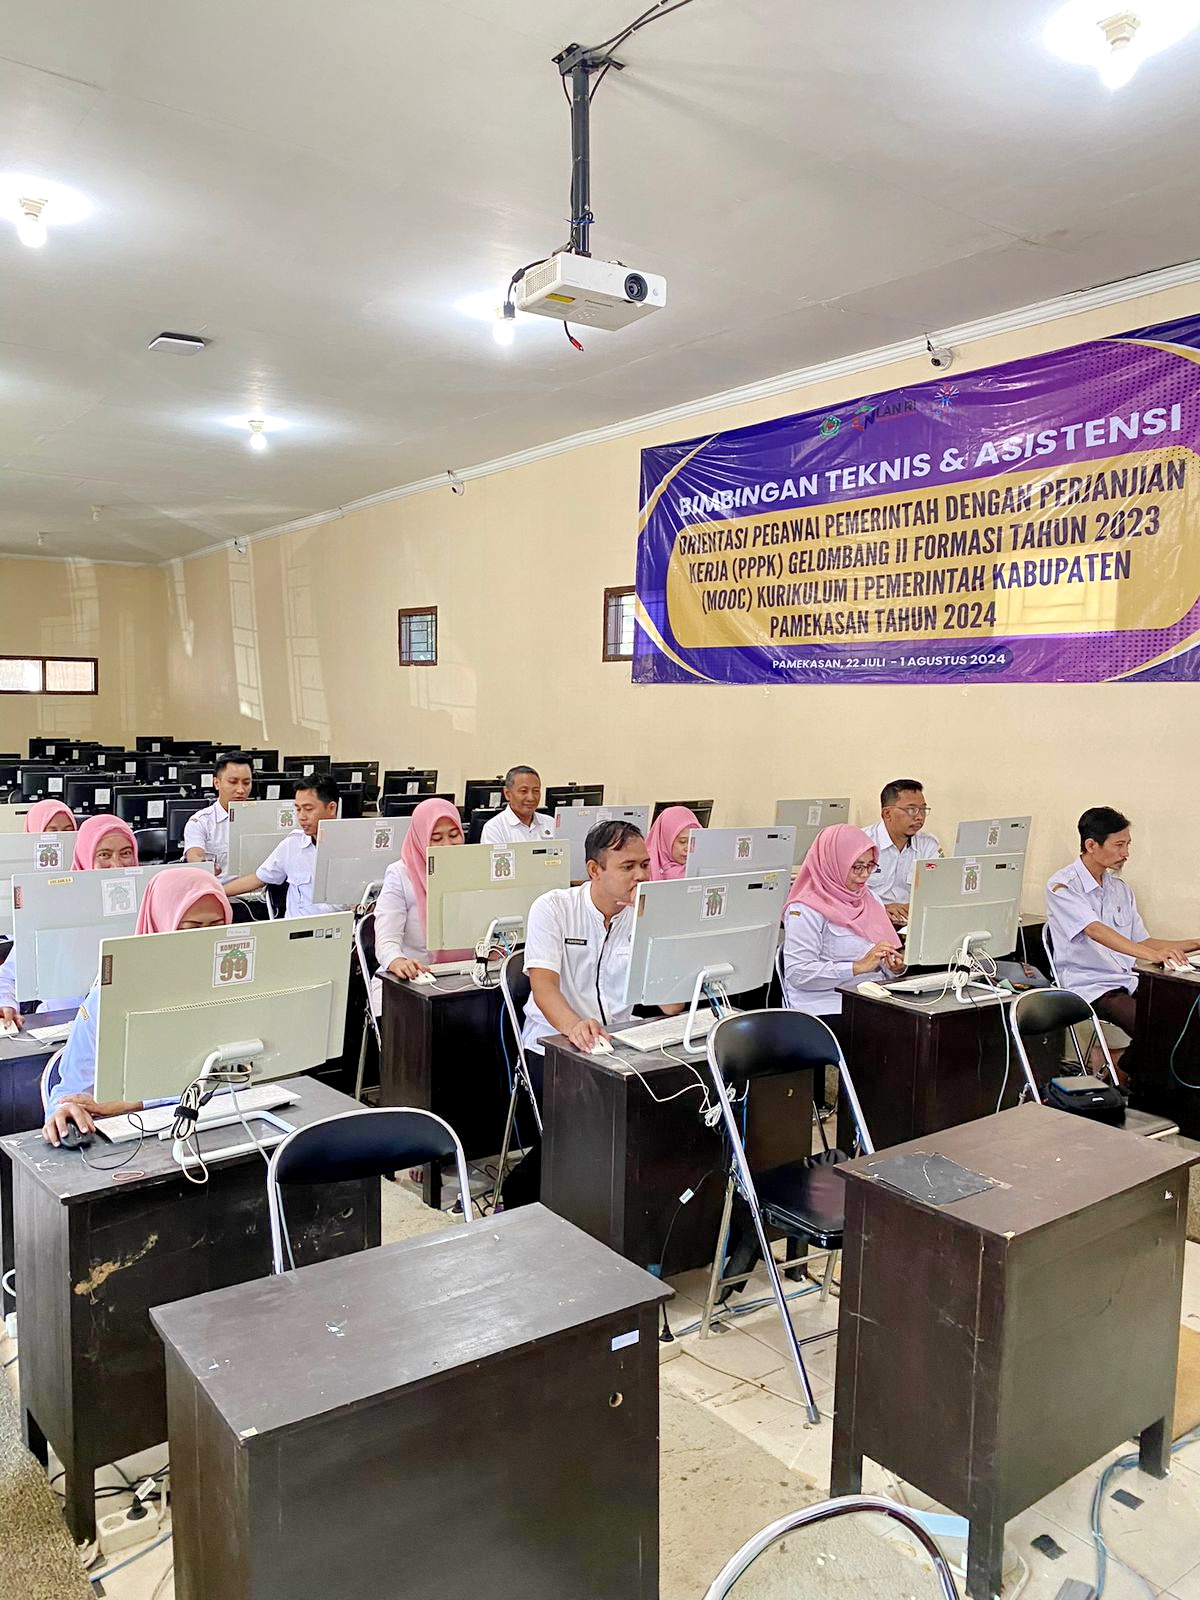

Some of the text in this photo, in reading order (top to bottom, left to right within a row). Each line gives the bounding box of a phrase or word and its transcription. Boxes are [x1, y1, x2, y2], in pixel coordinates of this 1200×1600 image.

[679, 403, 1182, 517] BIMBINGAN TEKNIS & ASISTENSI
[679, 458, 1186, 556] ORIENTASI PEGAWAI PEMERINTAH DENGAN PERJANJIAN
[689, 505, 1161, 584] KERJA (PPPK) GELOMBANG II FORMASI TAHUN 2023
[702, 550, 1132, 615] (MOOC) KURIKULUM I PEMERINTAH KABUPATEN
[770, 601, 997, 638] PAMEKASAN TAHUN 2024
[772, 657, 844, 669] PAMEKASAN,
[846, 657, 860, 668] 22
[861, 657, 886, 667] JULI
[899, 656, 906, 667] 1
[907, 655, 968, 667] AGUSTUS
[970, 653, 1007, 665] 2024
[219, 942, 251, 952] KOMPUTER
[220, 956, 249, 982] 99
